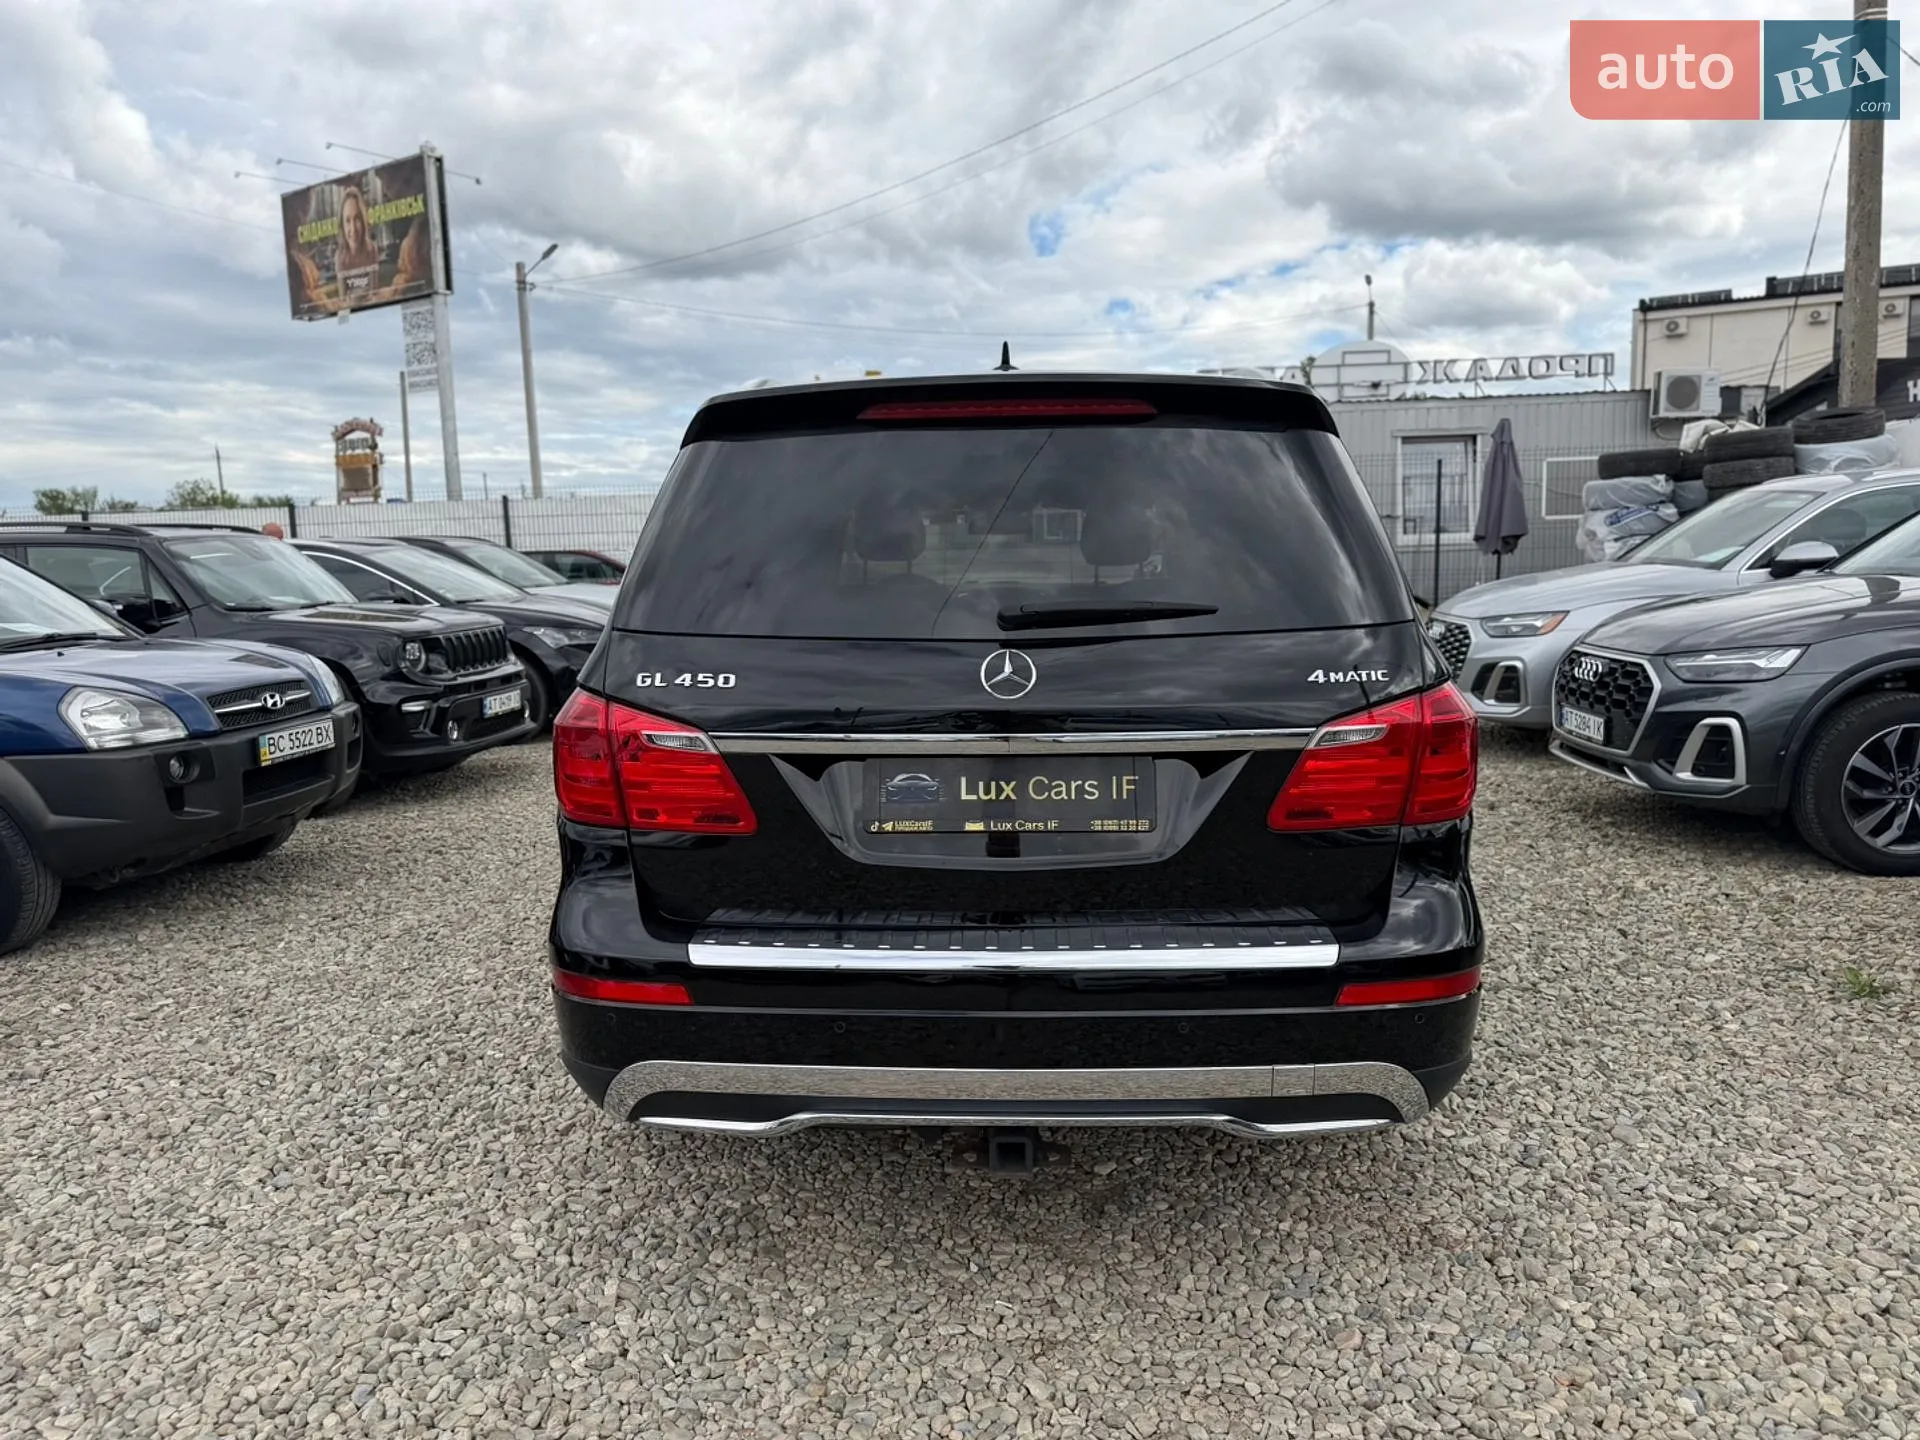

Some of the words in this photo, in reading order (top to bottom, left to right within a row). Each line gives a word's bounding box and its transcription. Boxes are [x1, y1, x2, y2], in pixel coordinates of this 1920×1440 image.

[636, 672, 668, 688] GL
[674, 673, 736, 688] 450
[1306, 669, 1390, 684] 4MATIC
[267, 735, 285, 755] BC
[288, 728, 314, 750] 5522
[316, 725, 331, 744] BX
[960, 776, 1017, 800] Lux
[1028, 776, 1099, 800] Cars
[1112, 775, 1139, 799] IF
[990, 820, 1012, 831] Lux
[1015, 820, 1044, 831] Cars
[1047, 820, 1060, 830] IF
